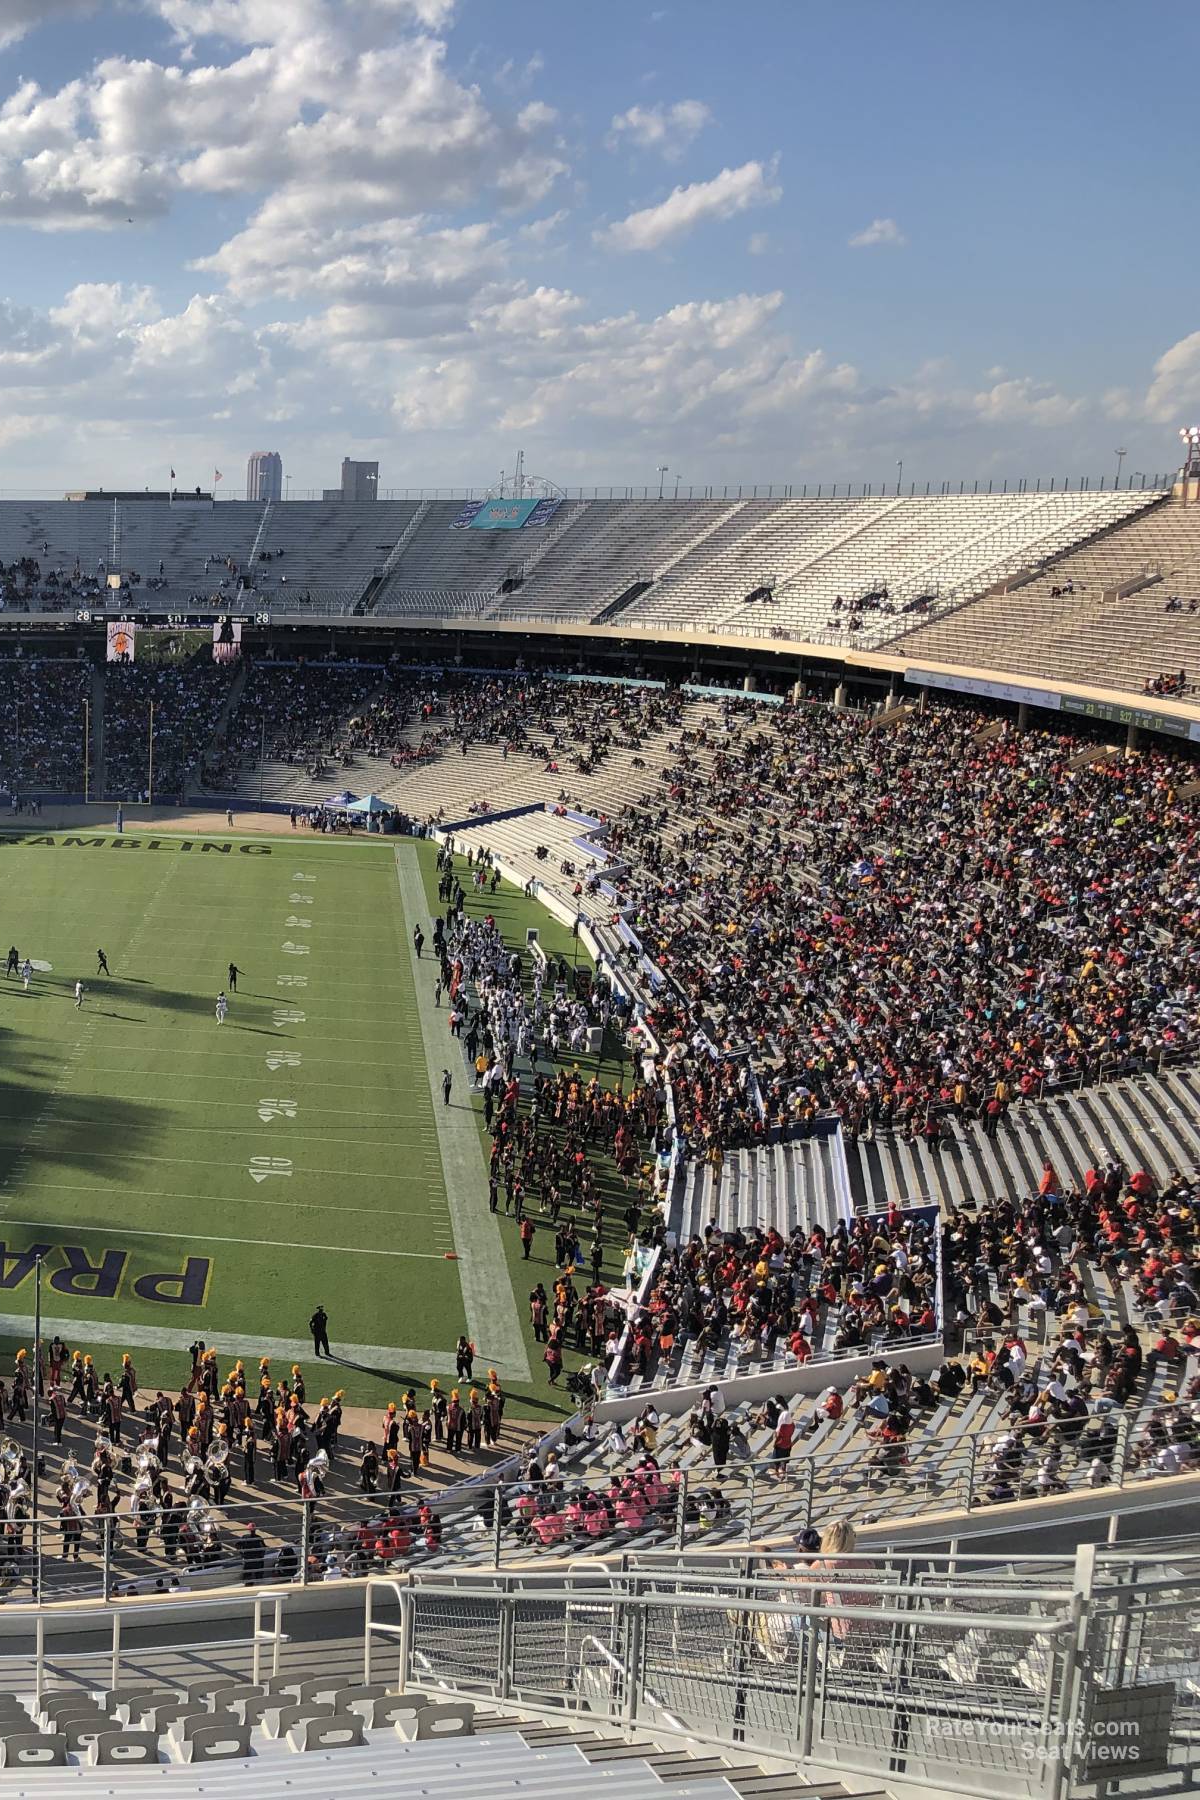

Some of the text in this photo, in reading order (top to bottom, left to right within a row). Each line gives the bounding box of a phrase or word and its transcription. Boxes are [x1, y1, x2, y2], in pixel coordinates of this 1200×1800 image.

[77, 611, 90, 621] 28
[256, 613, 269, 623] 28
[265, 1051, 302, 1066] 30
[257, 1099, 298, 1118] 20
[249, 1156, 293, 1177] 10
